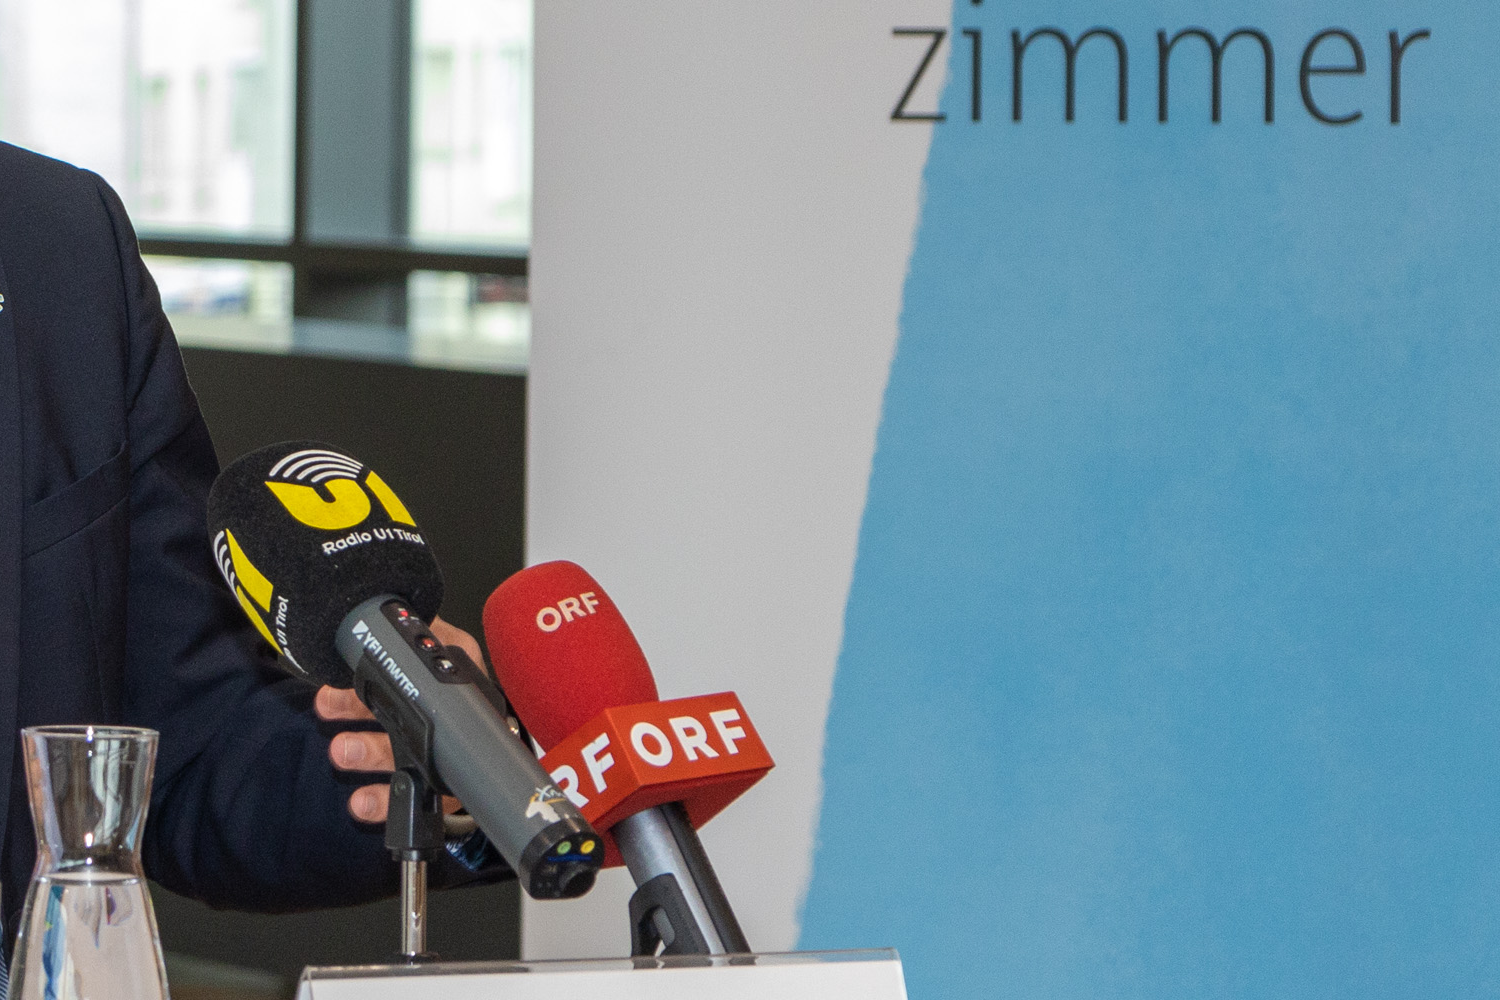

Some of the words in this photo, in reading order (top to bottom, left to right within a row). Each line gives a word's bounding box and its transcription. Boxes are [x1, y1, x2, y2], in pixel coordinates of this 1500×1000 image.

[321, 530, 373, 556] Radio
[373, 528, 394, 541] U1
[393, 528, 426, 546] Tirol
[275, 595, 289, 628] Tirol
[536, 591, 600, 633] ORF
[630, 708, 747, 768] ORF
[550, 731, 616, 809] RF
